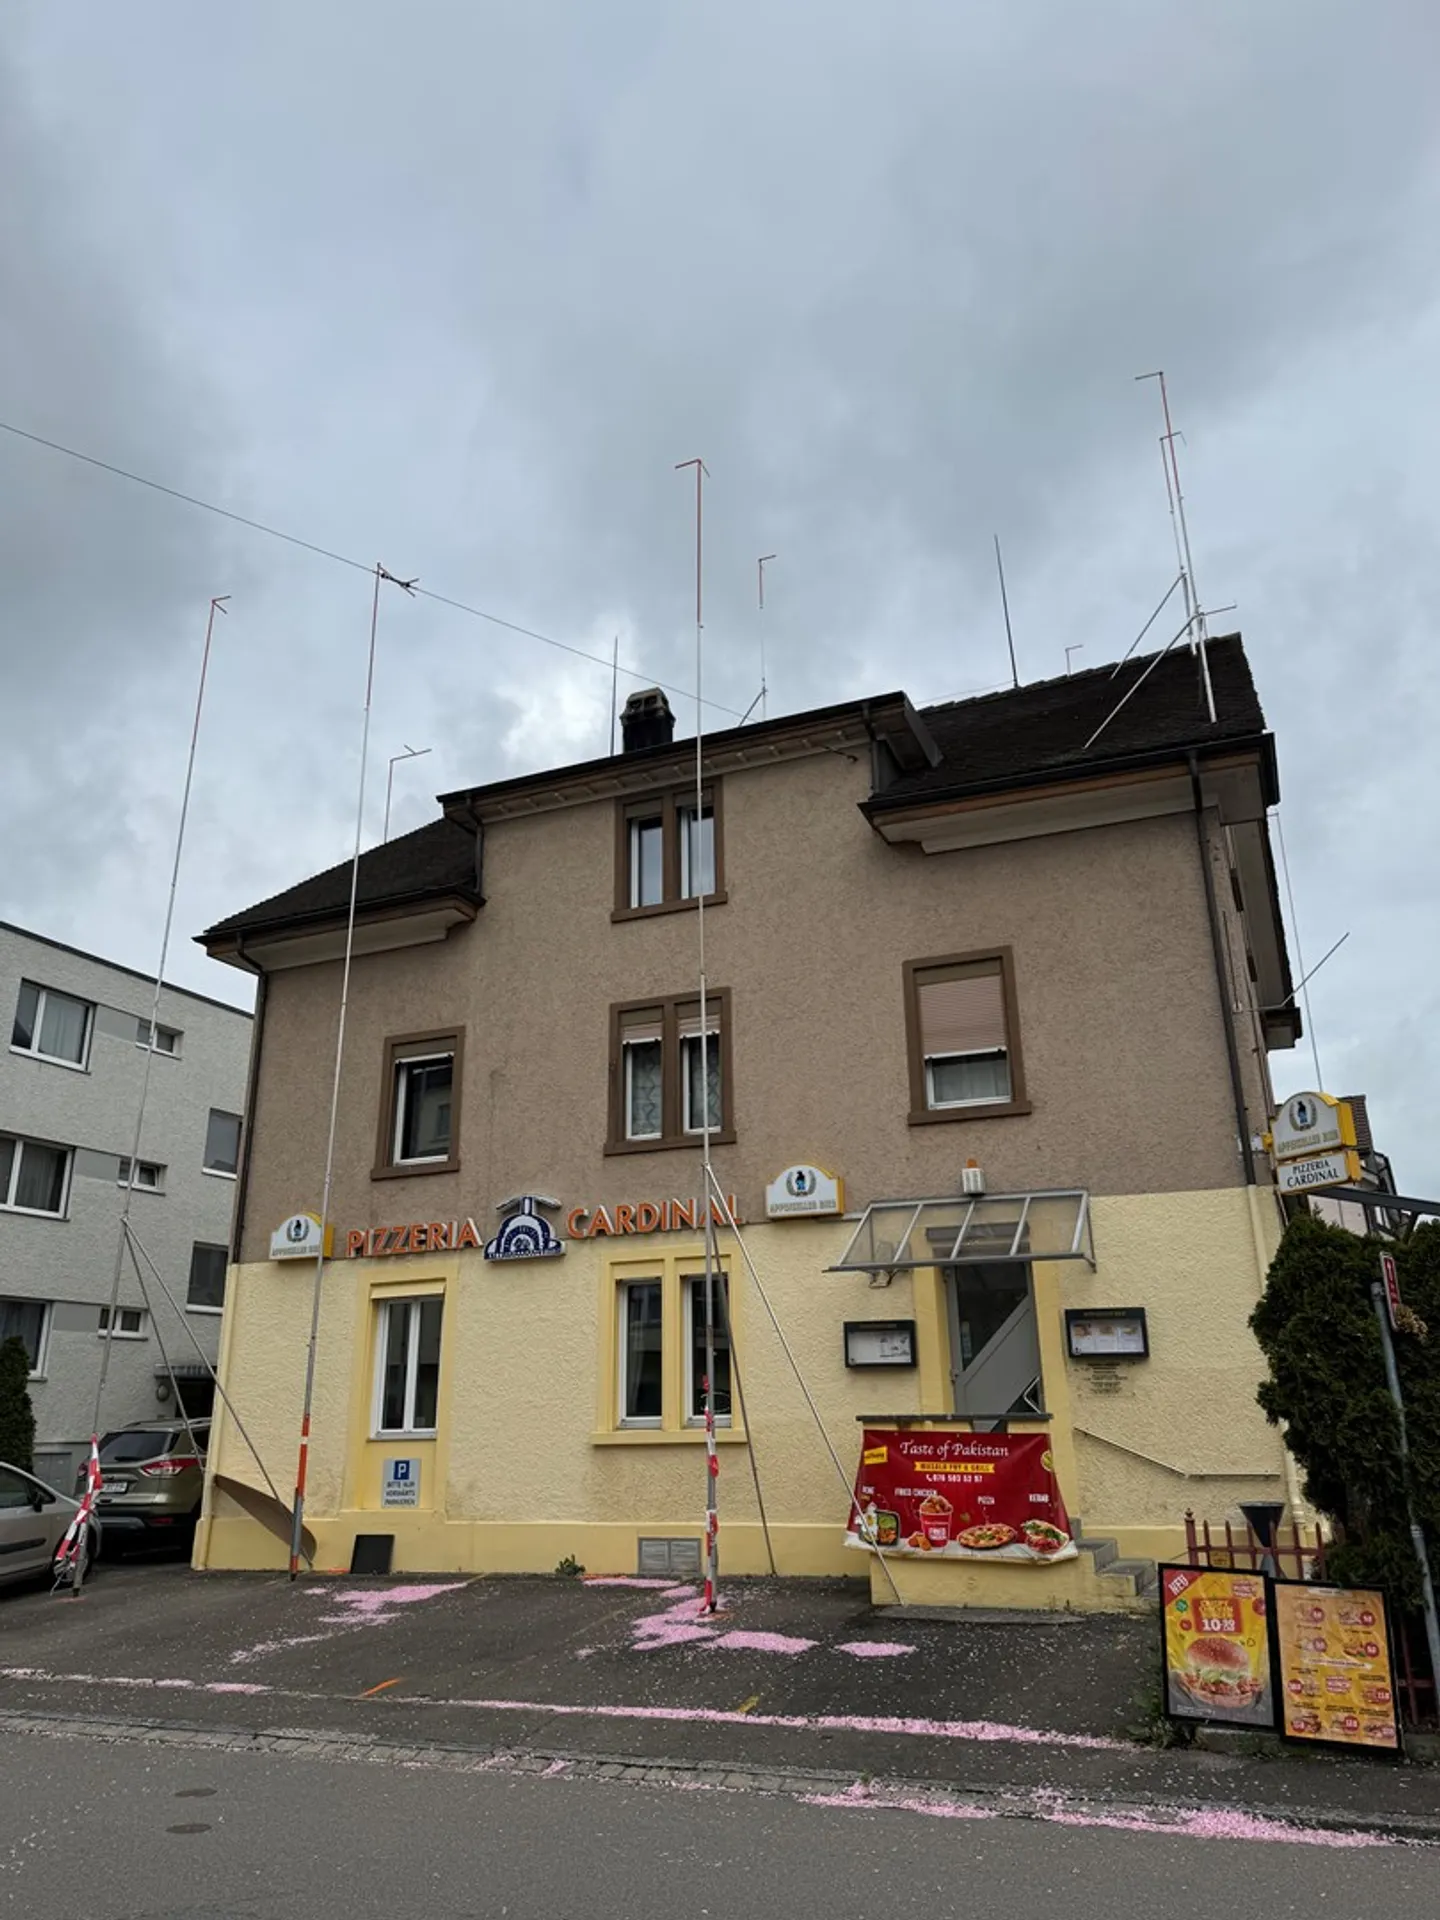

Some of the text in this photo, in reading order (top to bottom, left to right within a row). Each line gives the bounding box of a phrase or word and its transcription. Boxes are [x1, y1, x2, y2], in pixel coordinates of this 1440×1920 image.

[1292, 1159, 1330, 1175] PIZZERIA
[1287, 1168, 1339, 1188] CARDINAL
[567, 1194, 746, 1239] CARDINAL
[346, 1217, 484, 1259] PIZZERIA
[900, 1440, 934, 1455] Taste
[937, 1440, 951, 1461] of
[952, 1440, 1009, 1456] Pakistan
[397, 1463, 407, 1478] P
[978, 1496, 995, 1505] PIZZA
[1029, 1494, 1049, 1503] KEBAB
[1167, 1573, 1189, 1595] NEU
